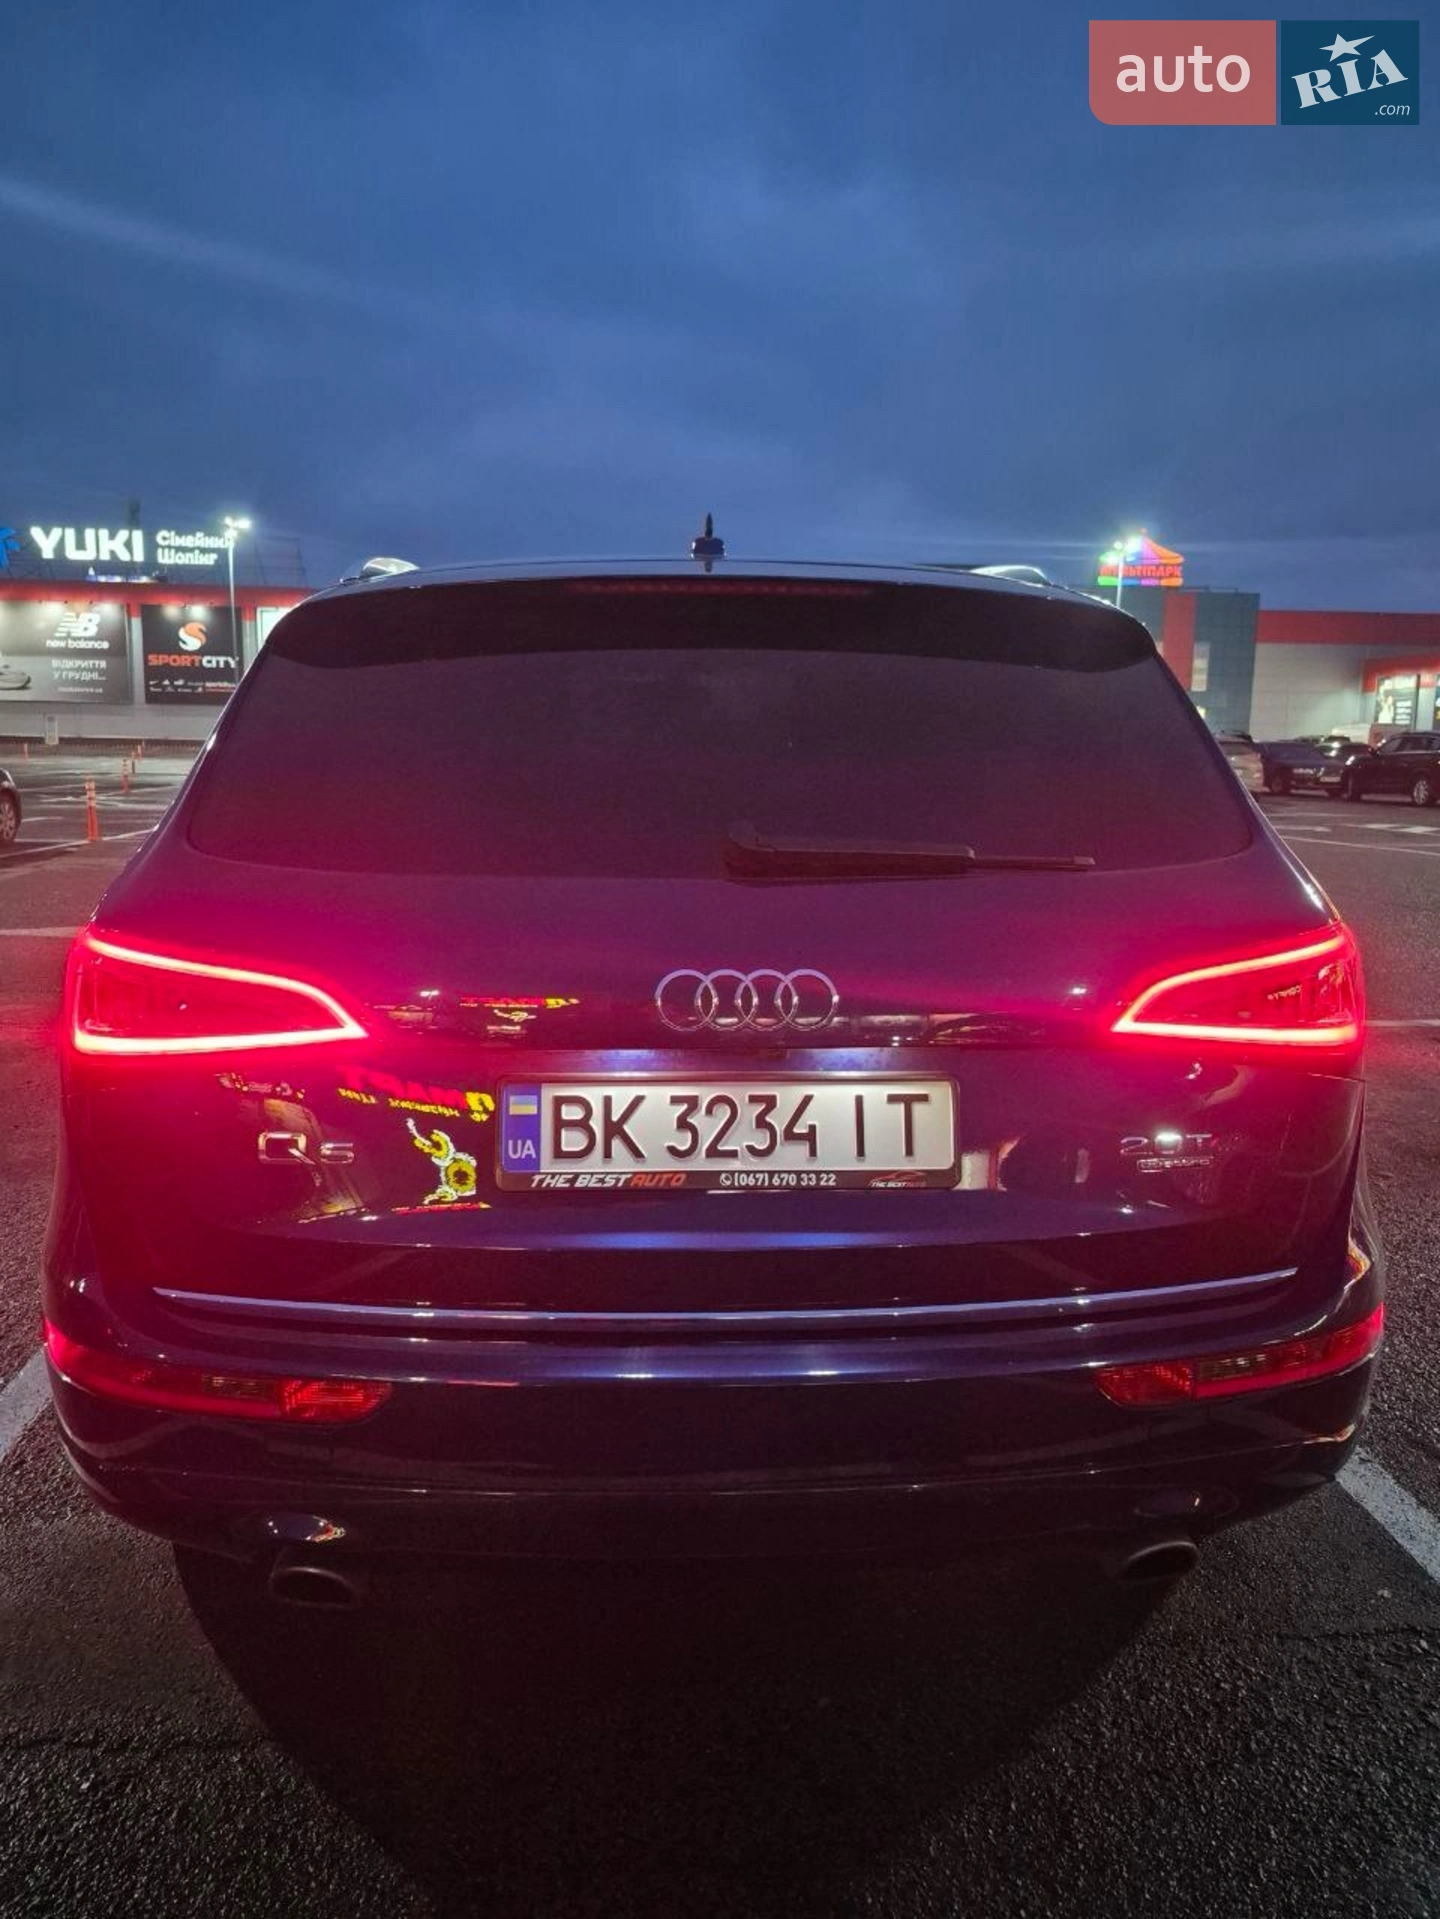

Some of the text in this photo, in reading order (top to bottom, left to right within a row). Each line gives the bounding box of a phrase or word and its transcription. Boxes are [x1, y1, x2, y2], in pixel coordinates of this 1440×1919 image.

[30, 526, 145, 562] YUKI
[157, 547, 218, 565] Шопінг
[46, 638, 110, 649] new balance
[52, 660, 107, 669] ВІДКРИТТЯ
[552, 1094, 647, 1160] BK
[665, 1093, 818, 1160] 3234
[258, 1132, 355, 1165] Q5
[508, 1140, 537, 1159] UA
[530, 1174, 573, 1188] THE
[734, 1172, 837, 1187] (067) 670 33 22
